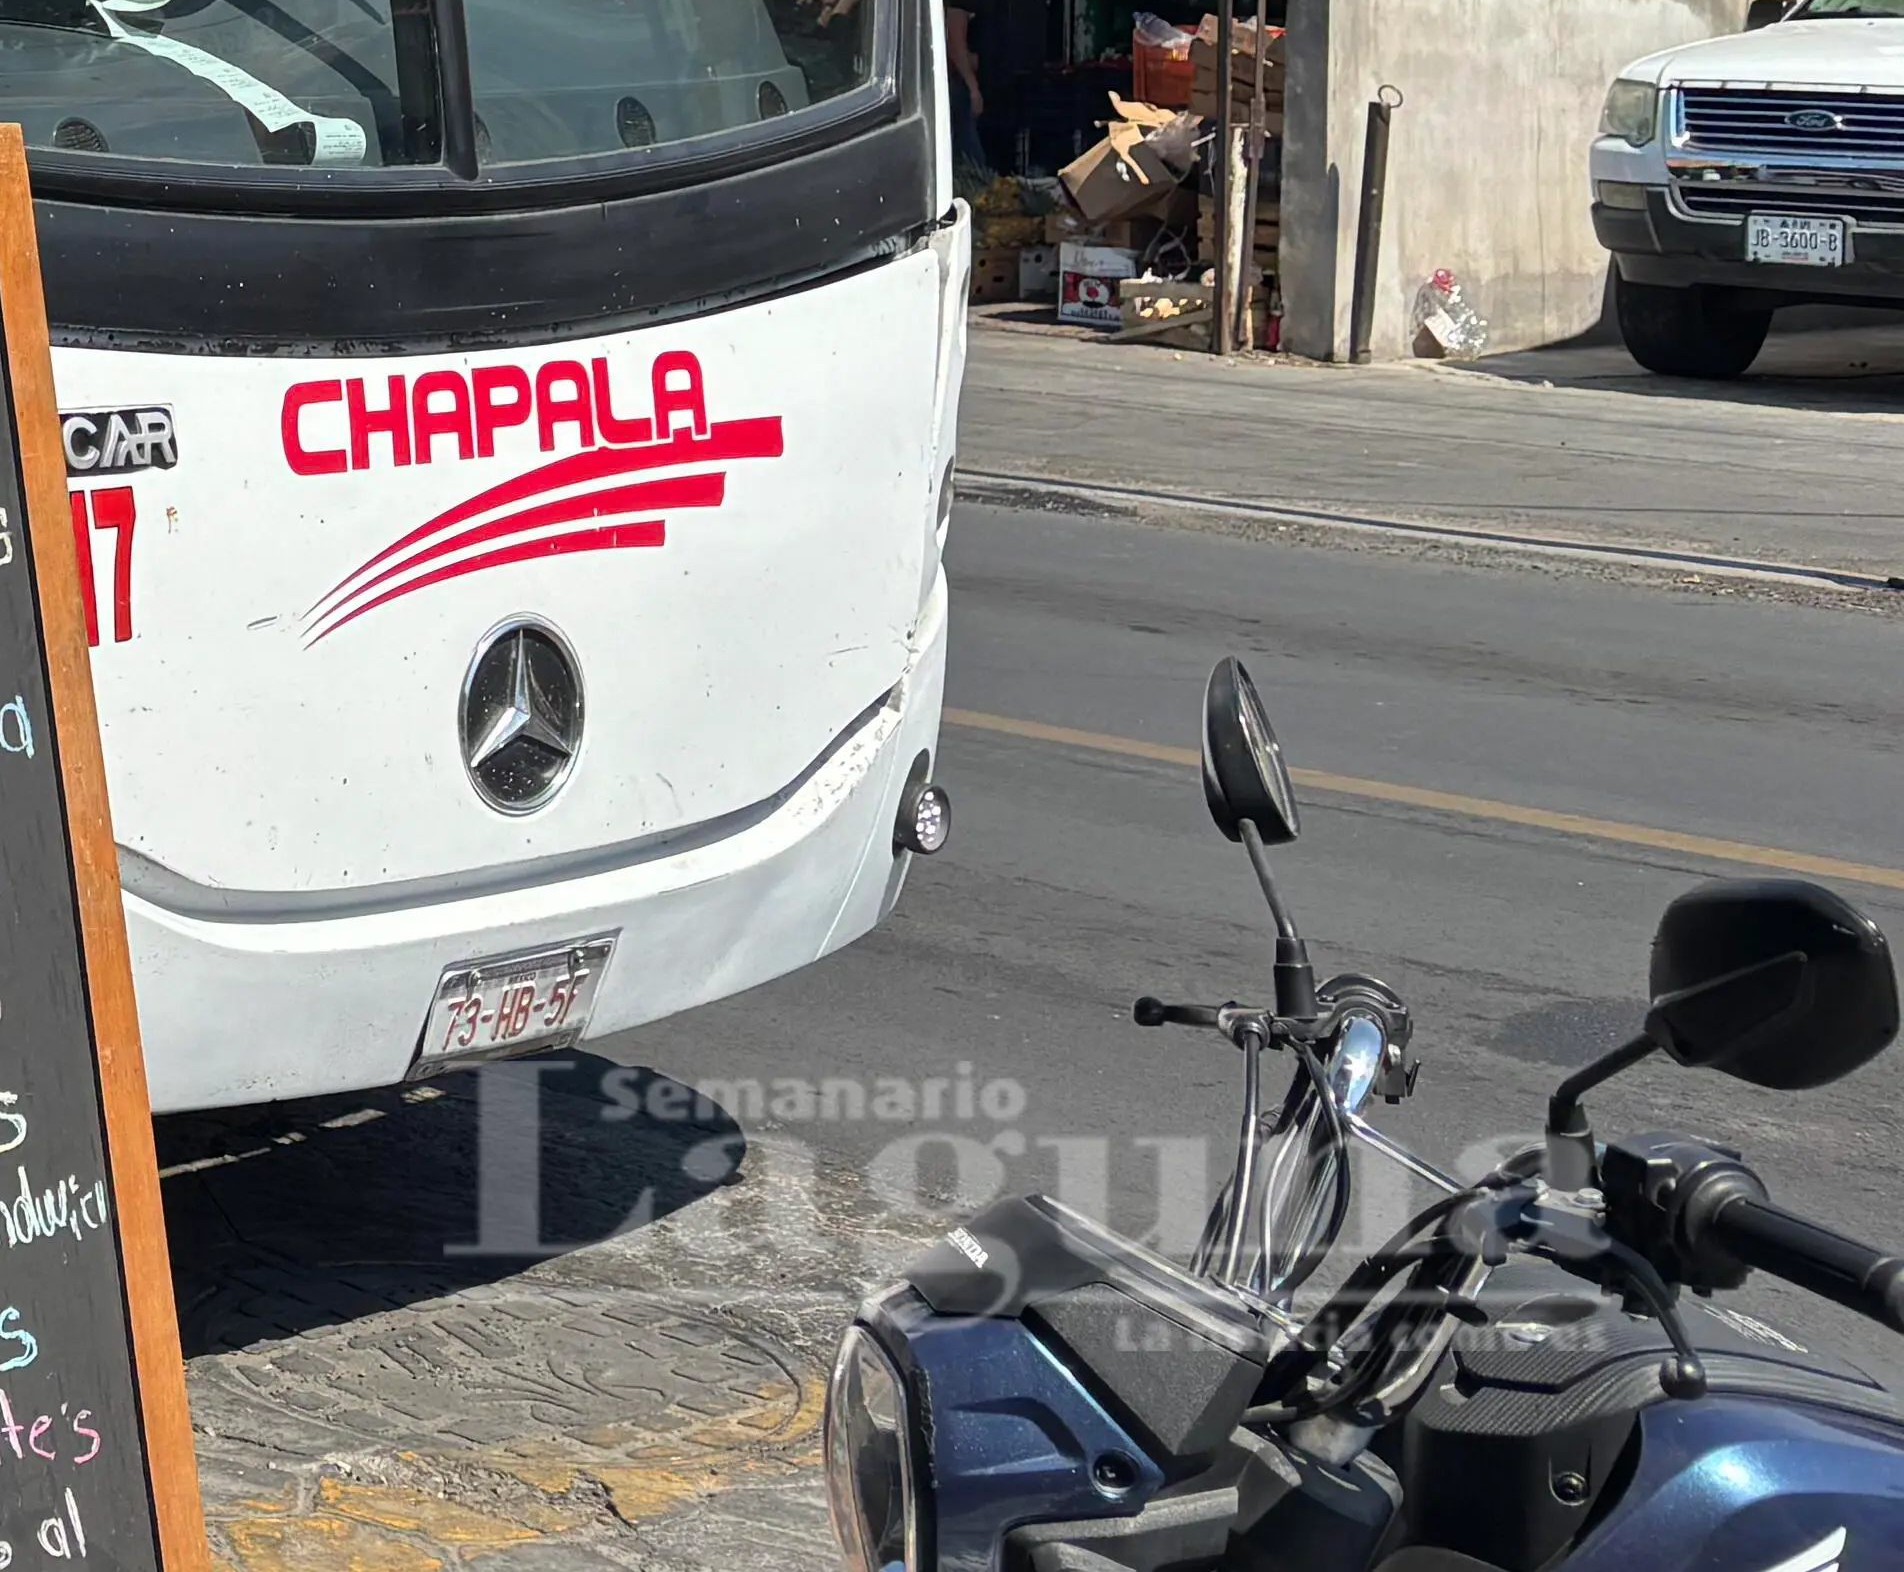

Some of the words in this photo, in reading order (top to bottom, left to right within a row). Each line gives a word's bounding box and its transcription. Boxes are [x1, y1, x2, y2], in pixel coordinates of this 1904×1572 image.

[1794, 113, 1828, 129] Ford
[63, 411, 176, 470] CAR
[282, 350, 708, 476] CHAPALA
[38, 1487, 87, 1559] al
